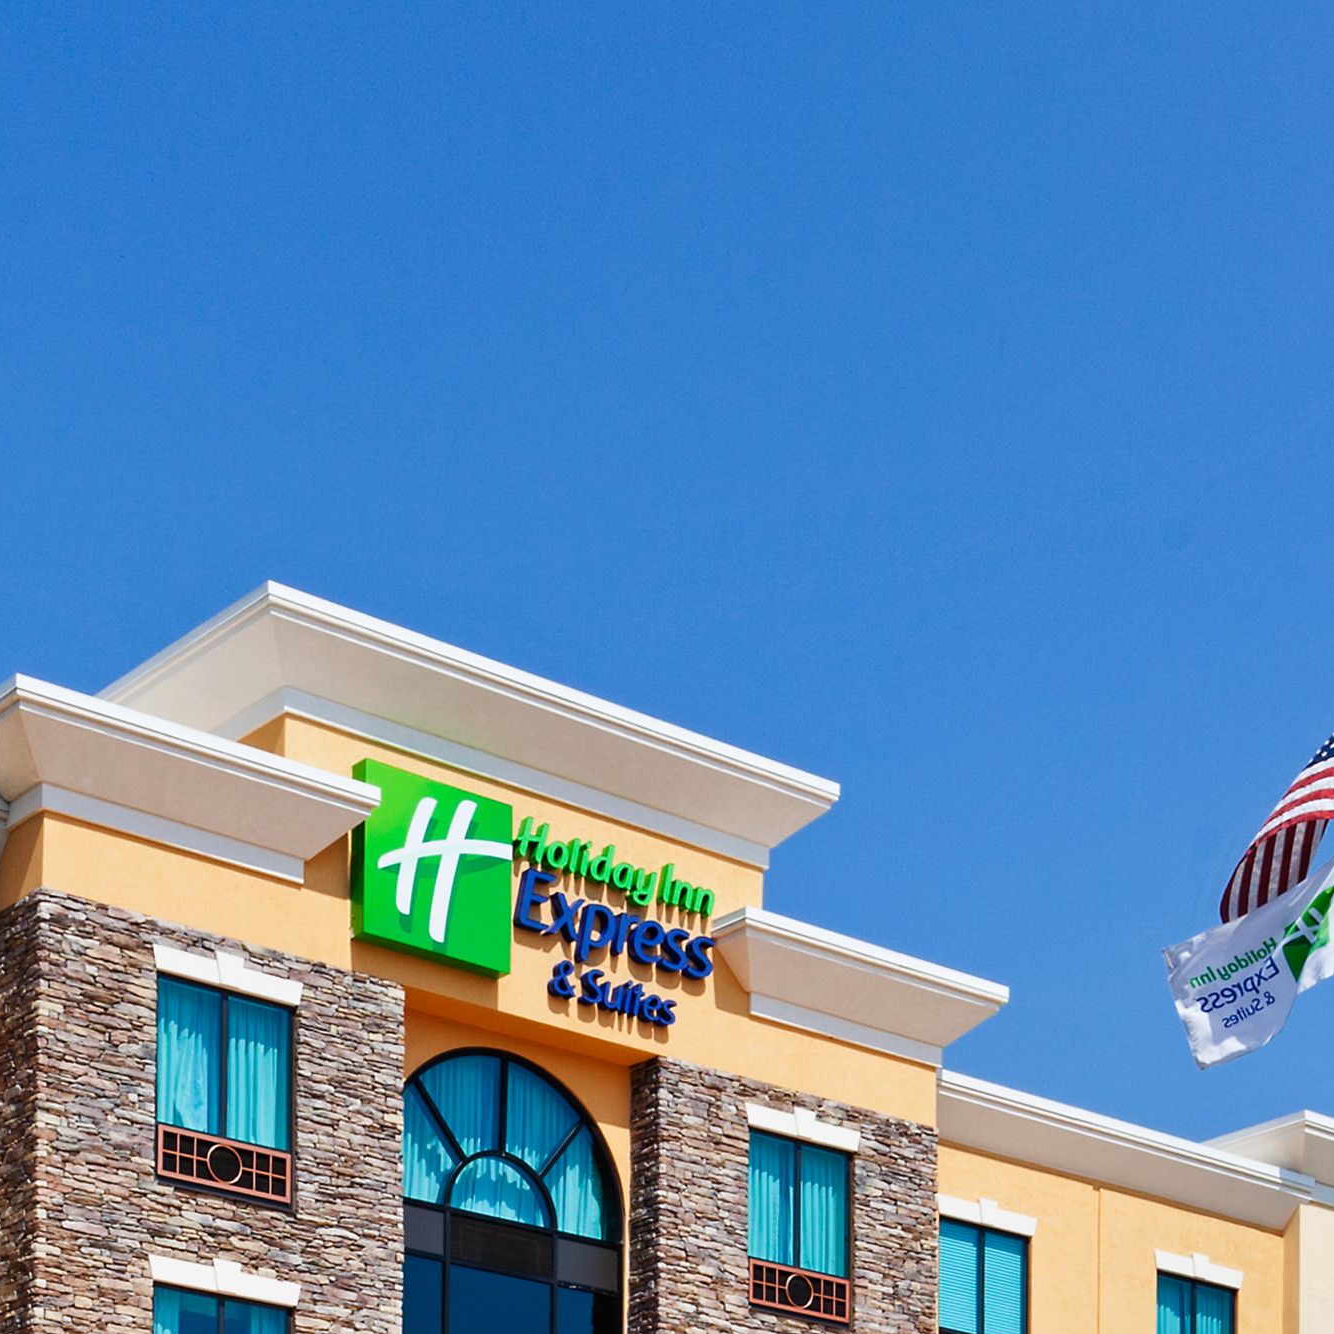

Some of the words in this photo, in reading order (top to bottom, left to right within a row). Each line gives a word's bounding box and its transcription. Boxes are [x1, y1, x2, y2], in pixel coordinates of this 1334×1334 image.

[517, 816, 657, 906] Holiday
[657, 862, 715, 918] Inn
[513, 866, 716, 981] Express
[548, 960, 576, 998] &
[580, 968, 678, 1027] Suites
